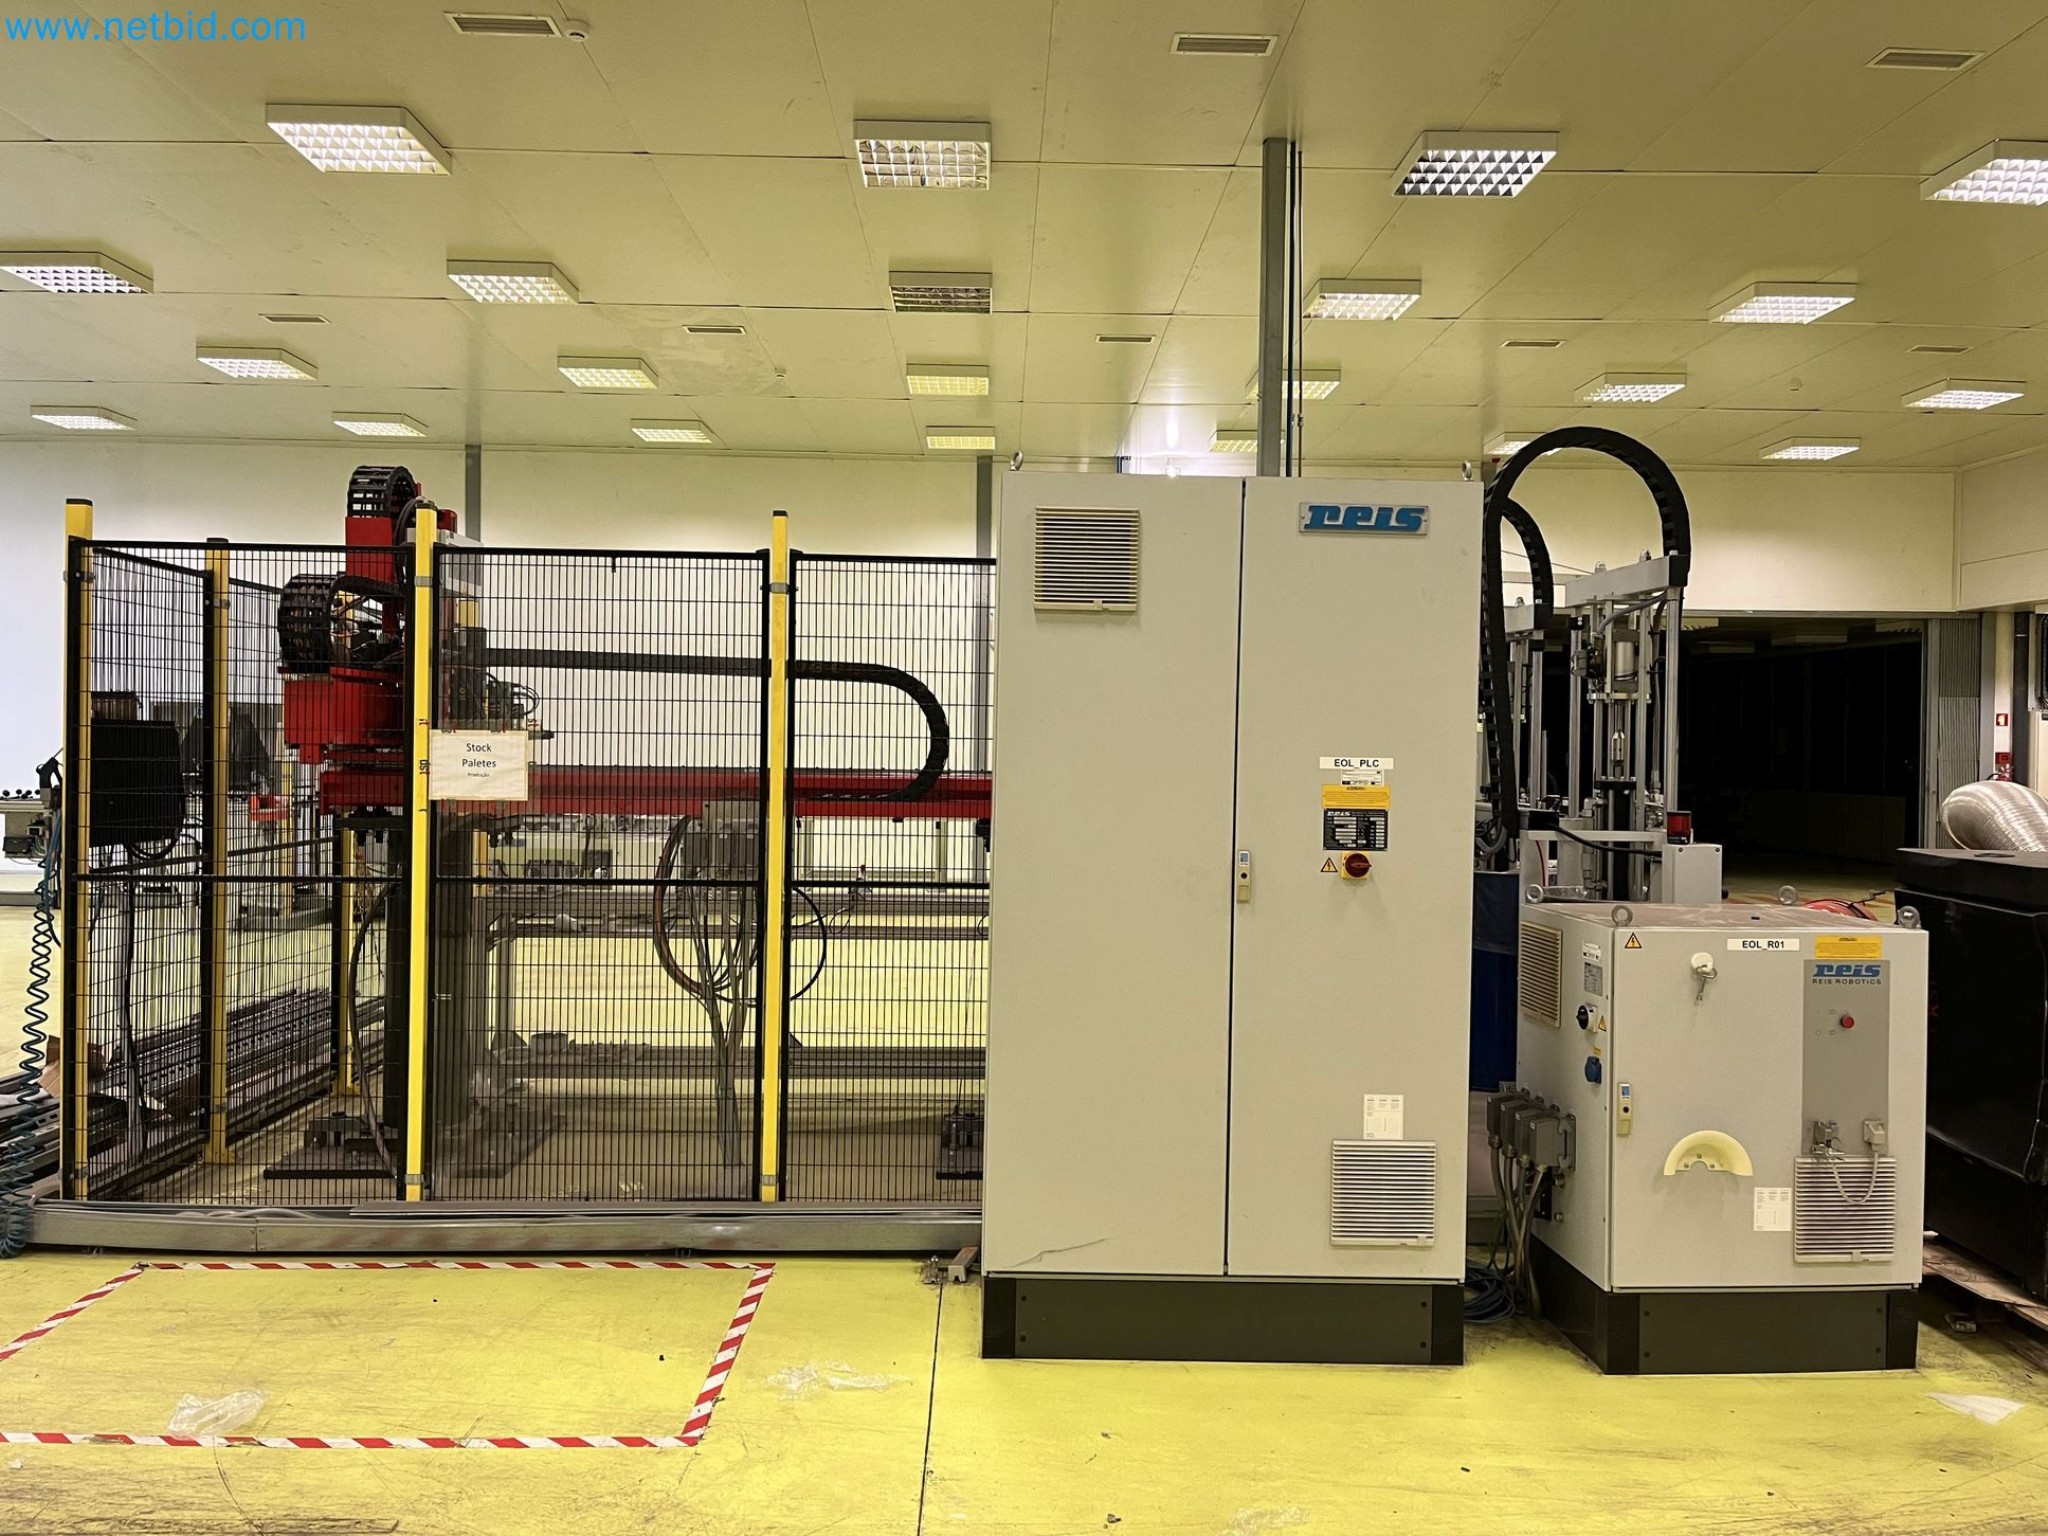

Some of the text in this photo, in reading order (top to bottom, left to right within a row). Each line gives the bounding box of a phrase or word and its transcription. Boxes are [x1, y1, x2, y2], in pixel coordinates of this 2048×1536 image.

[466, 742, 492, 752] Stock
[461, 758, 497, 768] Paletes
[1334, 758, 1379, 768] EOL_PLC
[1742, 940, 1785, 951] EOL_R01
